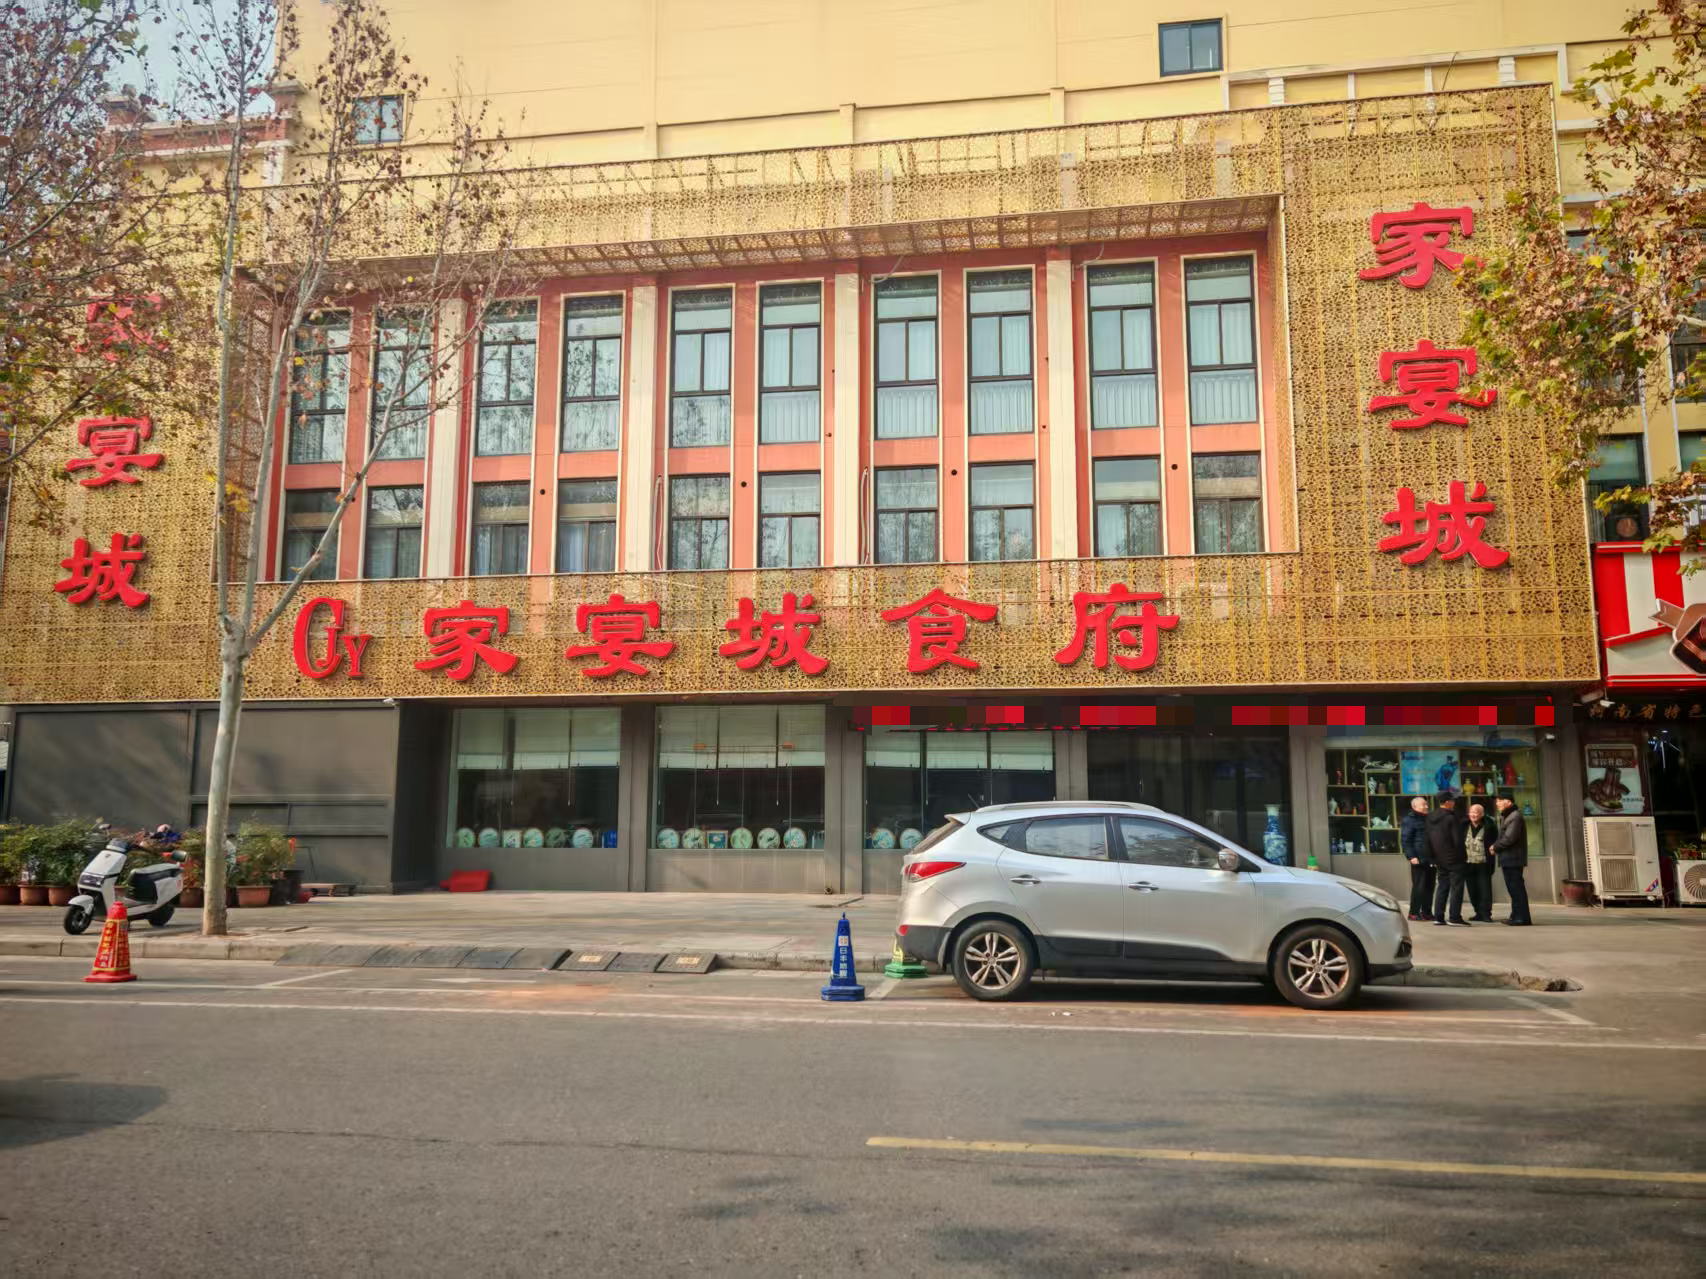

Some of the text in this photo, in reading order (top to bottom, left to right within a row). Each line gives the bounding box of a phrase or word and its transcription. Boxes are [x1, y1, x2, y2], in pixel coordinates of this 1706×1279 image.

[1359, 201, 1510, 569] 家宴城
[413, 583, 1182, 681] 家宴城食府
